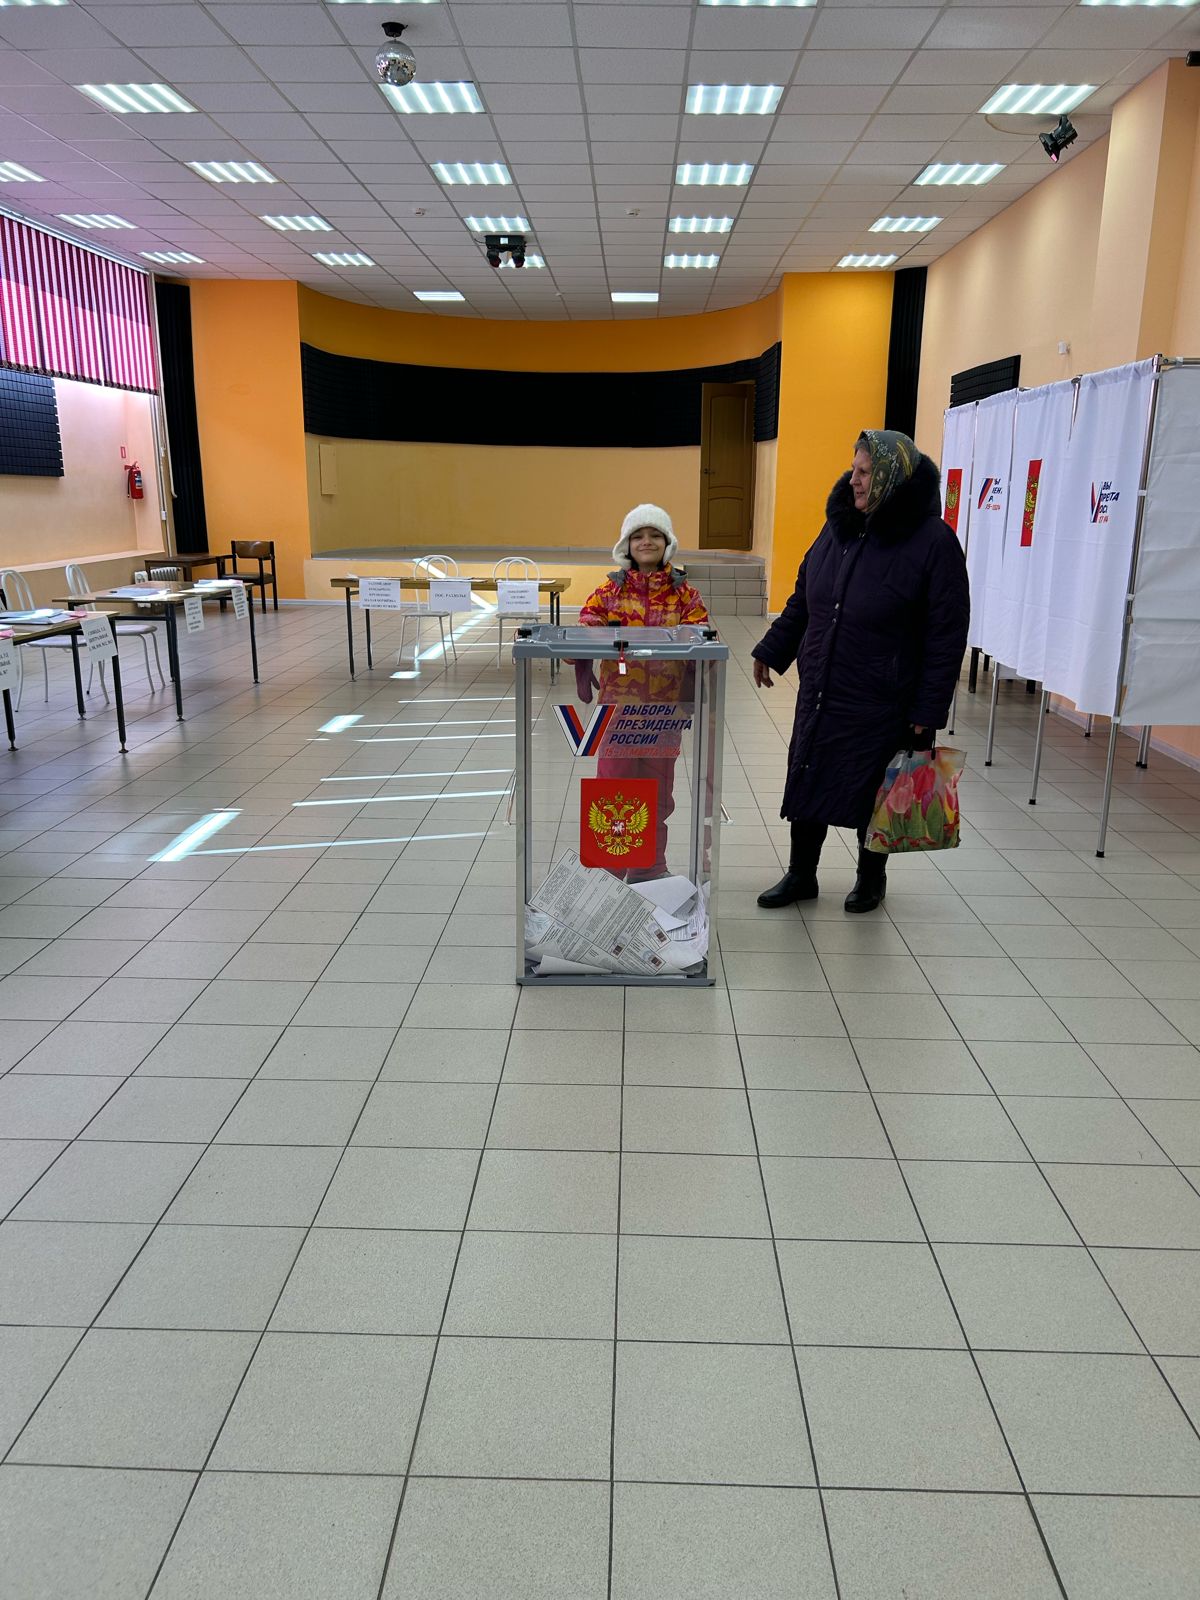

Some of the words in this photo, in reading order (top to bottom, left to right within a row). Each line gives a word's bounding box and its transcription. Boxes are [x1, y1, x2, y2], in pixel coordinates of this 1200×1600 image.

[621, 704, 676, 716] ВЫБОРЫ
[615, 719, 693, 731] ПРЕЗИДЕНТА
[608, 734, 659, 745] РОССИИ
